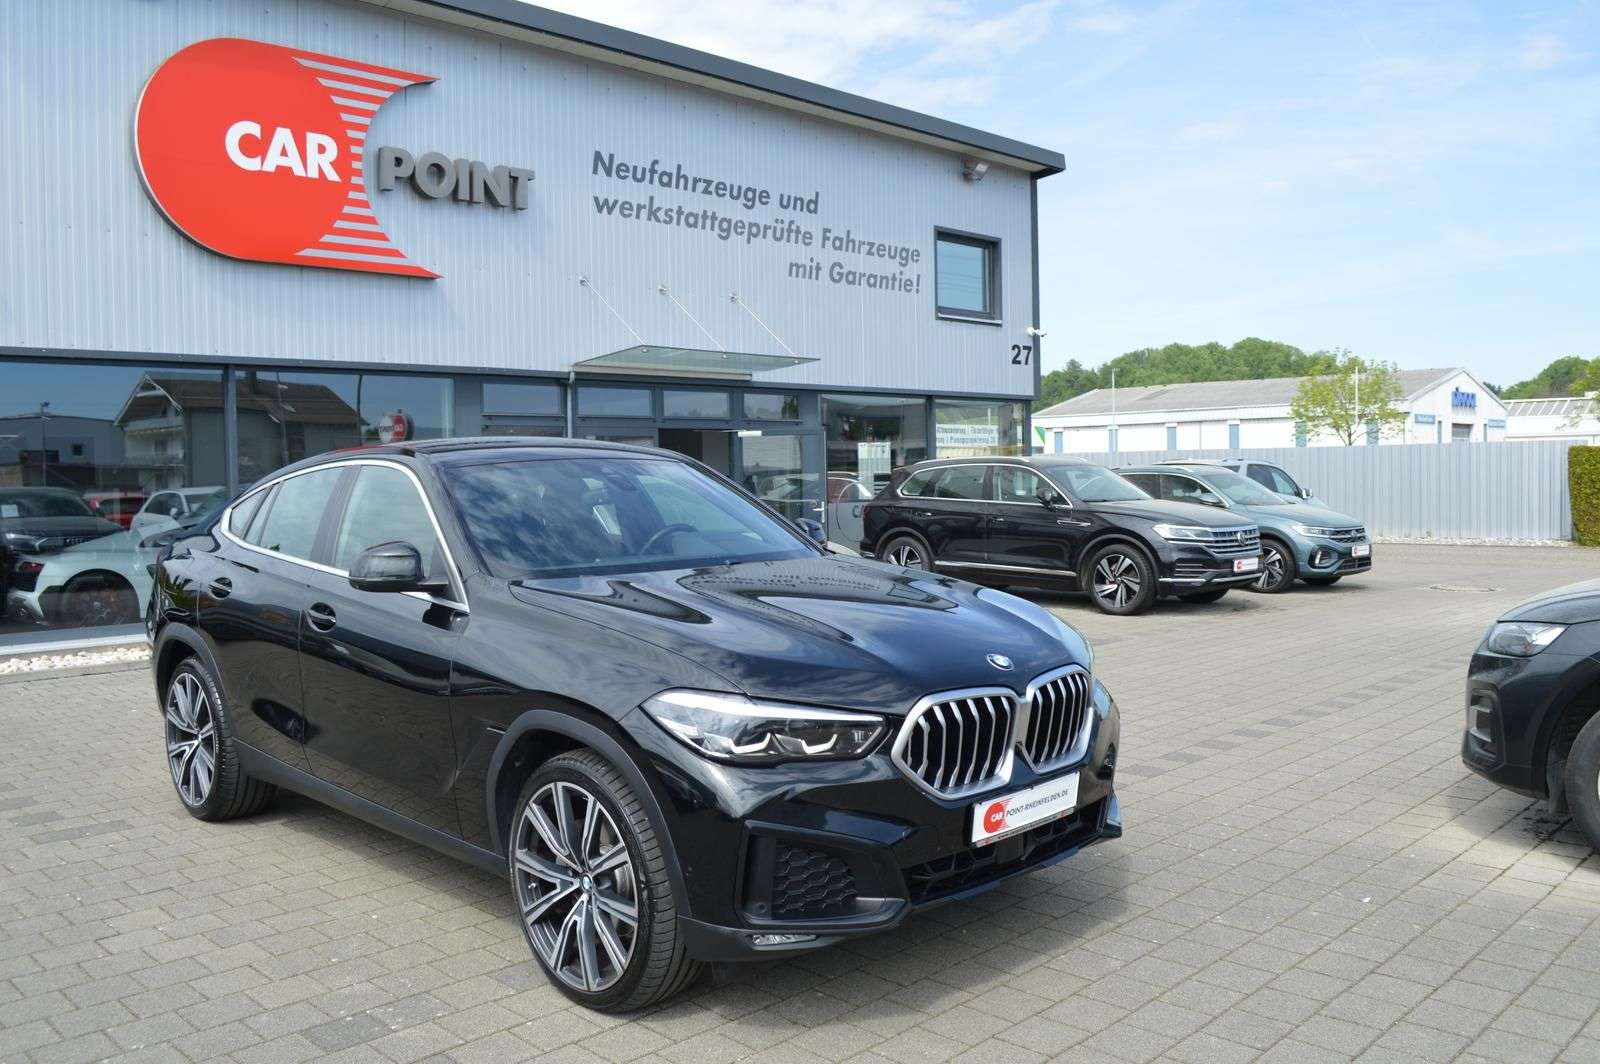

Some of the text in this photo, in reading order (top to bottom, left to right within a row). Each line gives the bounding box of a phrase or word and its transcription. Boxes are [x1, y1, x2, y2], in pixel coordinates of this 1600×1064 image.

[224, 120, 536, 210] CAR POINT
[592, 150, 820, 215] Neufahrzeuge und
[593, 195, 921, 267] werkstattgeprüfte Fahrzeuge
[788, 257, 921, 294] mit Garantie!
[1011, 344, 1033, 366] 27
